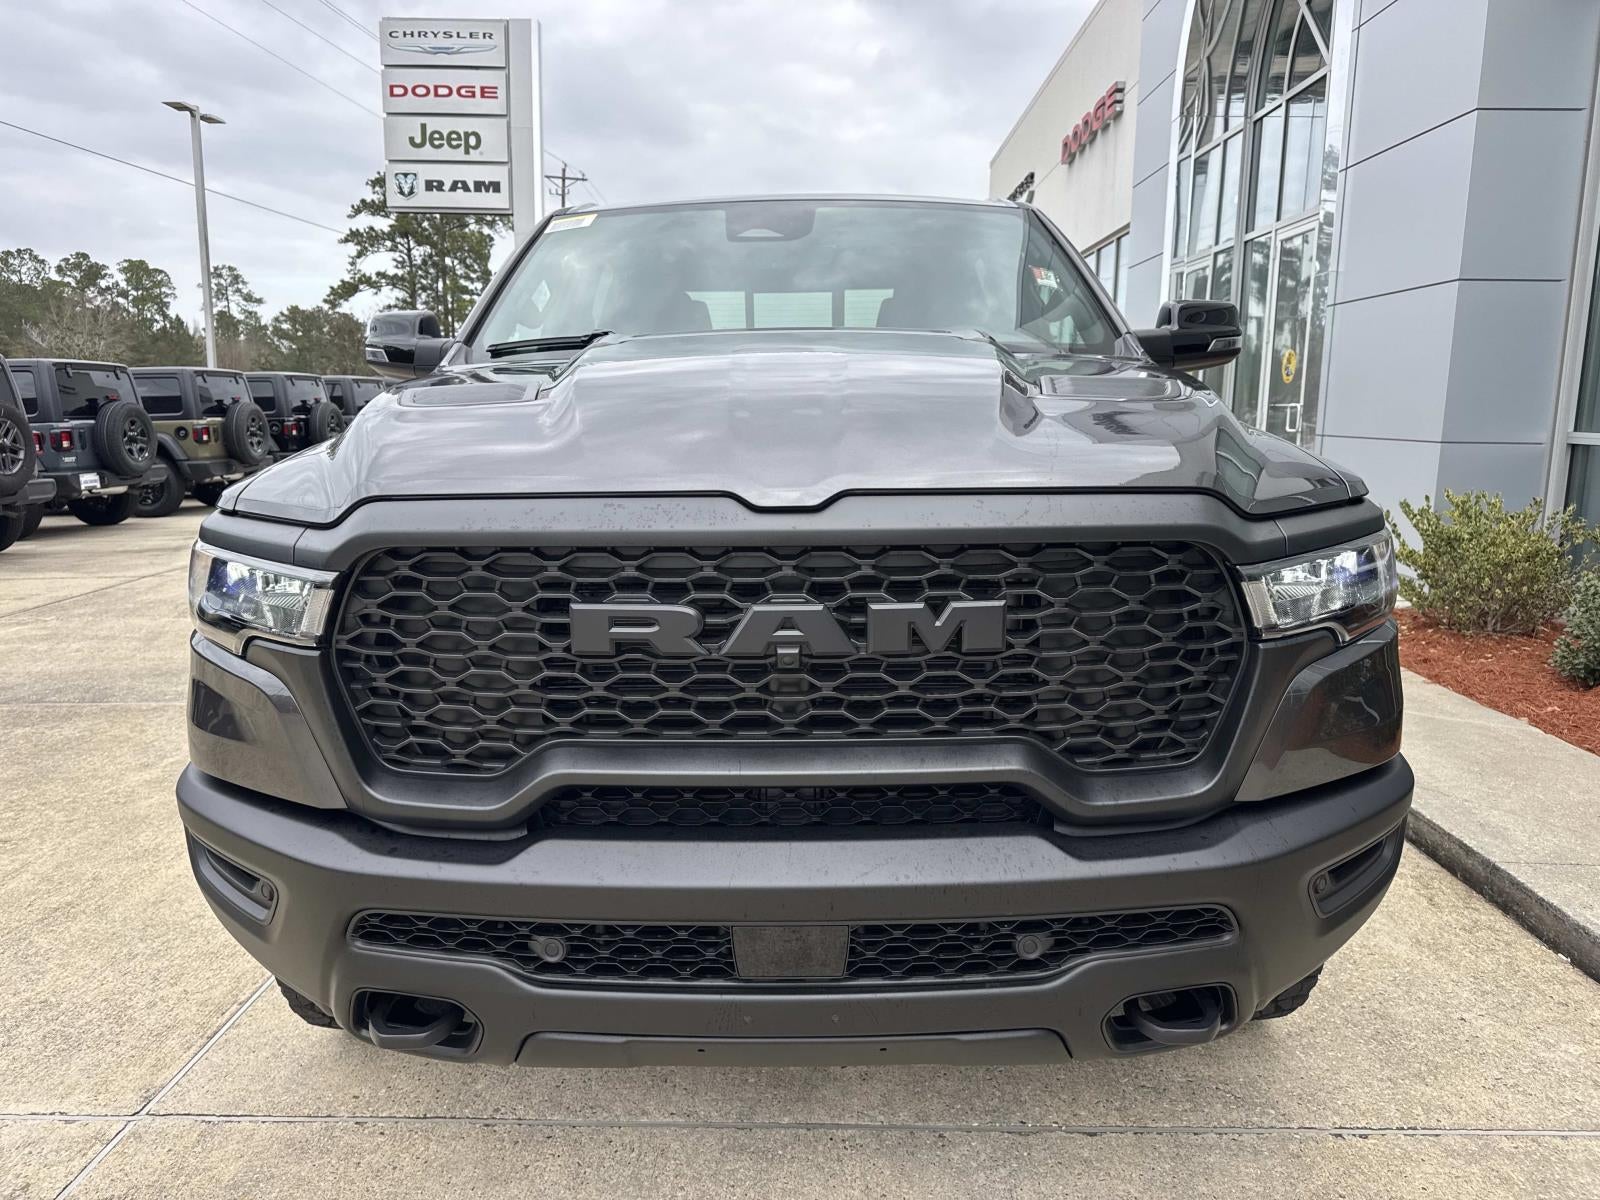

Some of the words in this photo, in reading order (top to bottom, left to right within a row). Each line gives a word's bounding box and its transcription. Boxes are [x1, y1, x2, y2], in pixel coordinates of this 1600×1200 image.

[388, 30, 494, 40] CHRYSLER
[389, 84, 499, 99] DODGE
[1061, 81, 1126, 165] DODGE
[408, 122, 482, 155] Jeep
[424, 179, 501, 193] RAM
[569, 599, 1007, 656] RAM
